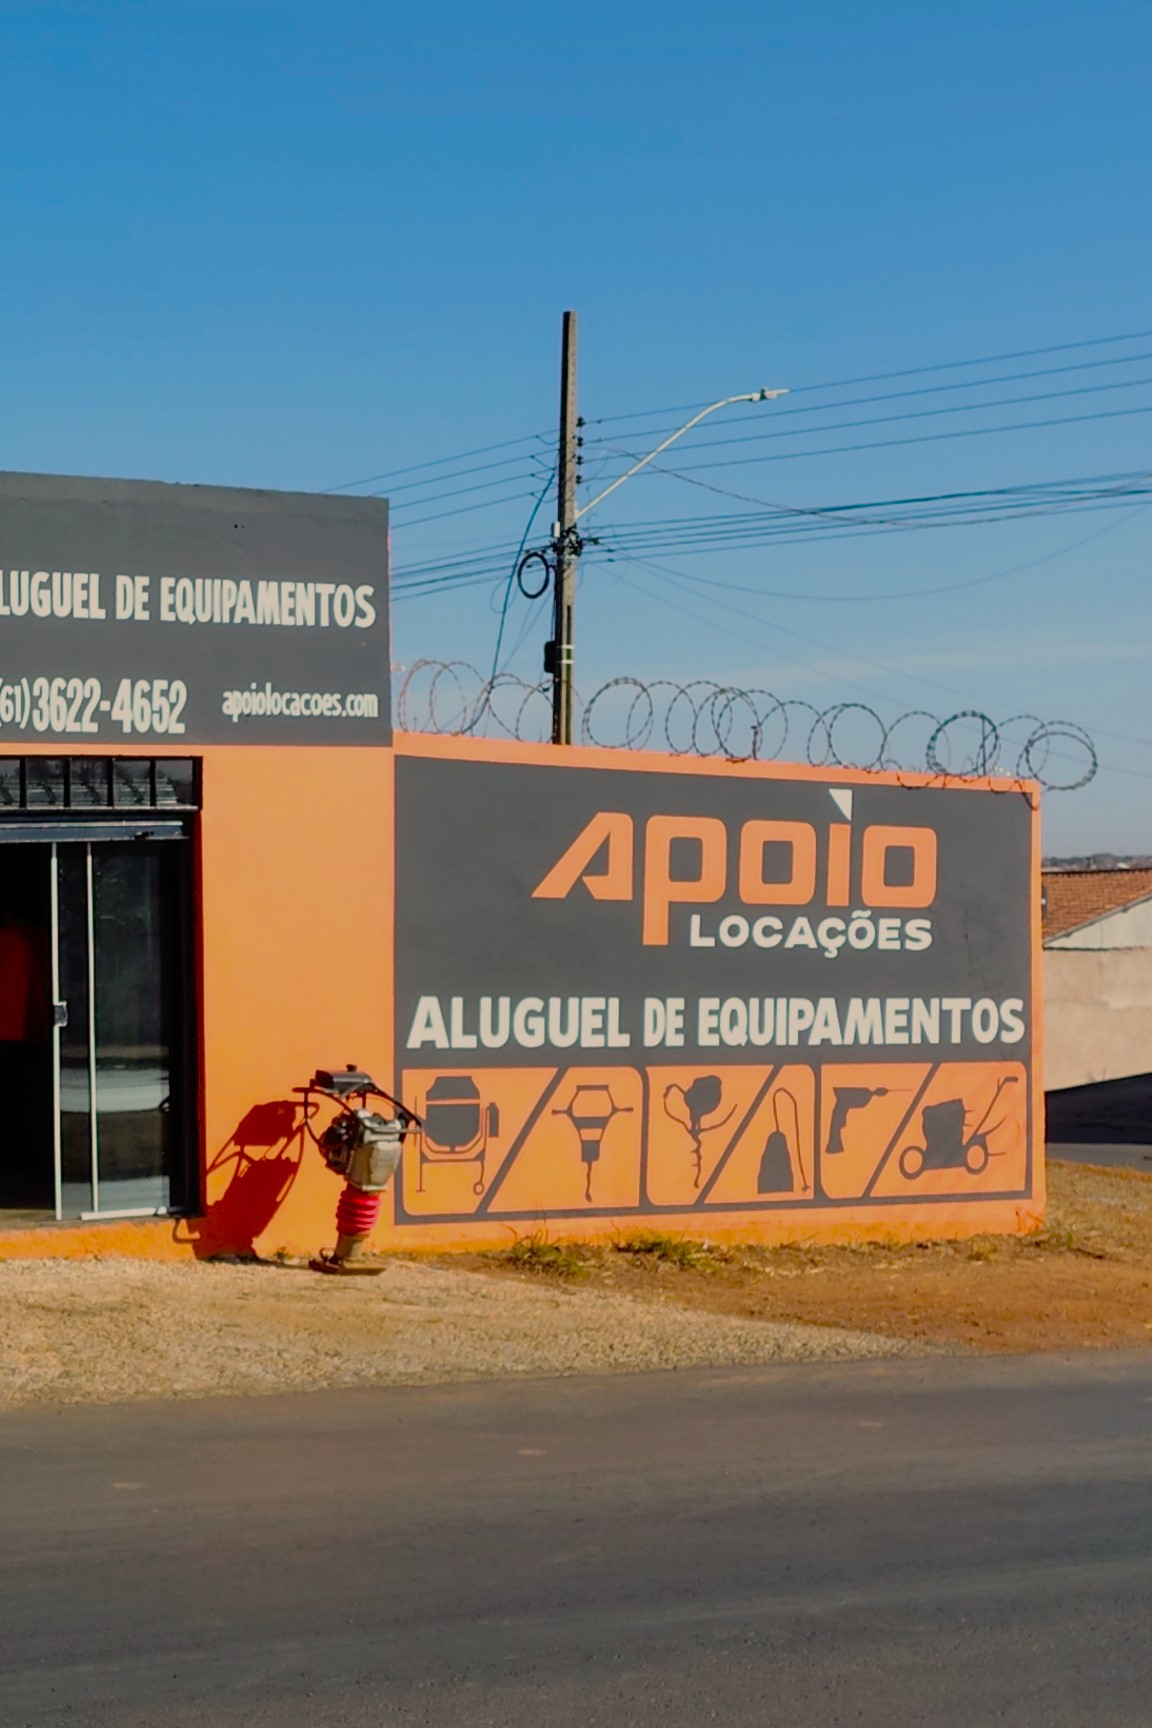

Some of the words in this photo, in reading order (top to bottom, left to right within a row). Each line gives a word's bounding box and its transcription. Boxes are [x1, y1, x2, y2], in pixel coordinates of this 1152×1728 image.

[115, 575, 151, 620] DE
[160, 576, 376, 628] EQUIPAMENTOS
[222, 682, 379, 721] apoiolocacoes.com
[690, 909, 933, 958] LOCAÇÕES
[406, 996, 631, 1049] ALUGUEL
[644, 997, 685, 1047] DE
[698, 997, 1026, 1046] EQUIPAMENTOS
